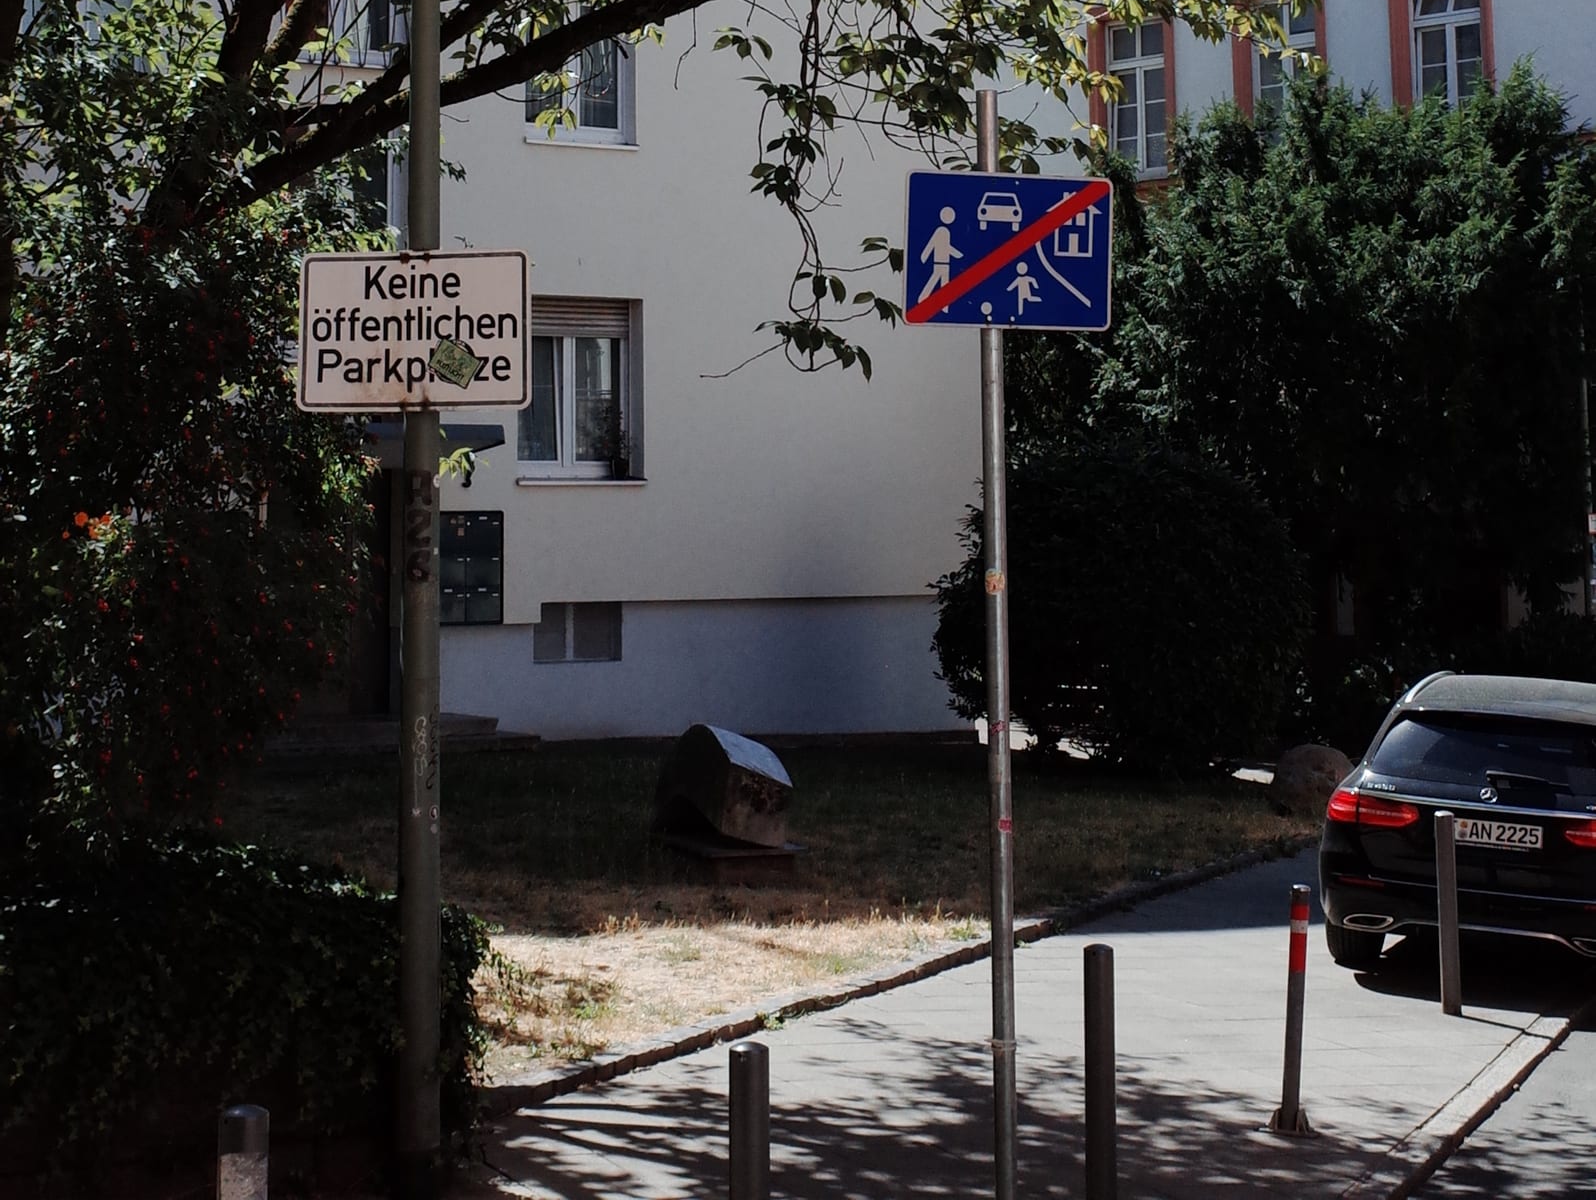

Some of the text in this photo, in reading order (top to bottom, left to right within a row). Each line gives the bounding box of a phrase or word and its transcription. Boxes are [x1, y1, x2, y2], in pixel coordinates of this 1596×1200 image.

[364, 265, 461, 300] Keine
[312, 305, 518, 341] öffentlichen
[317, 348, 511, 393] Parkplze
[1469, 821, 1540, 845] AN 2225
